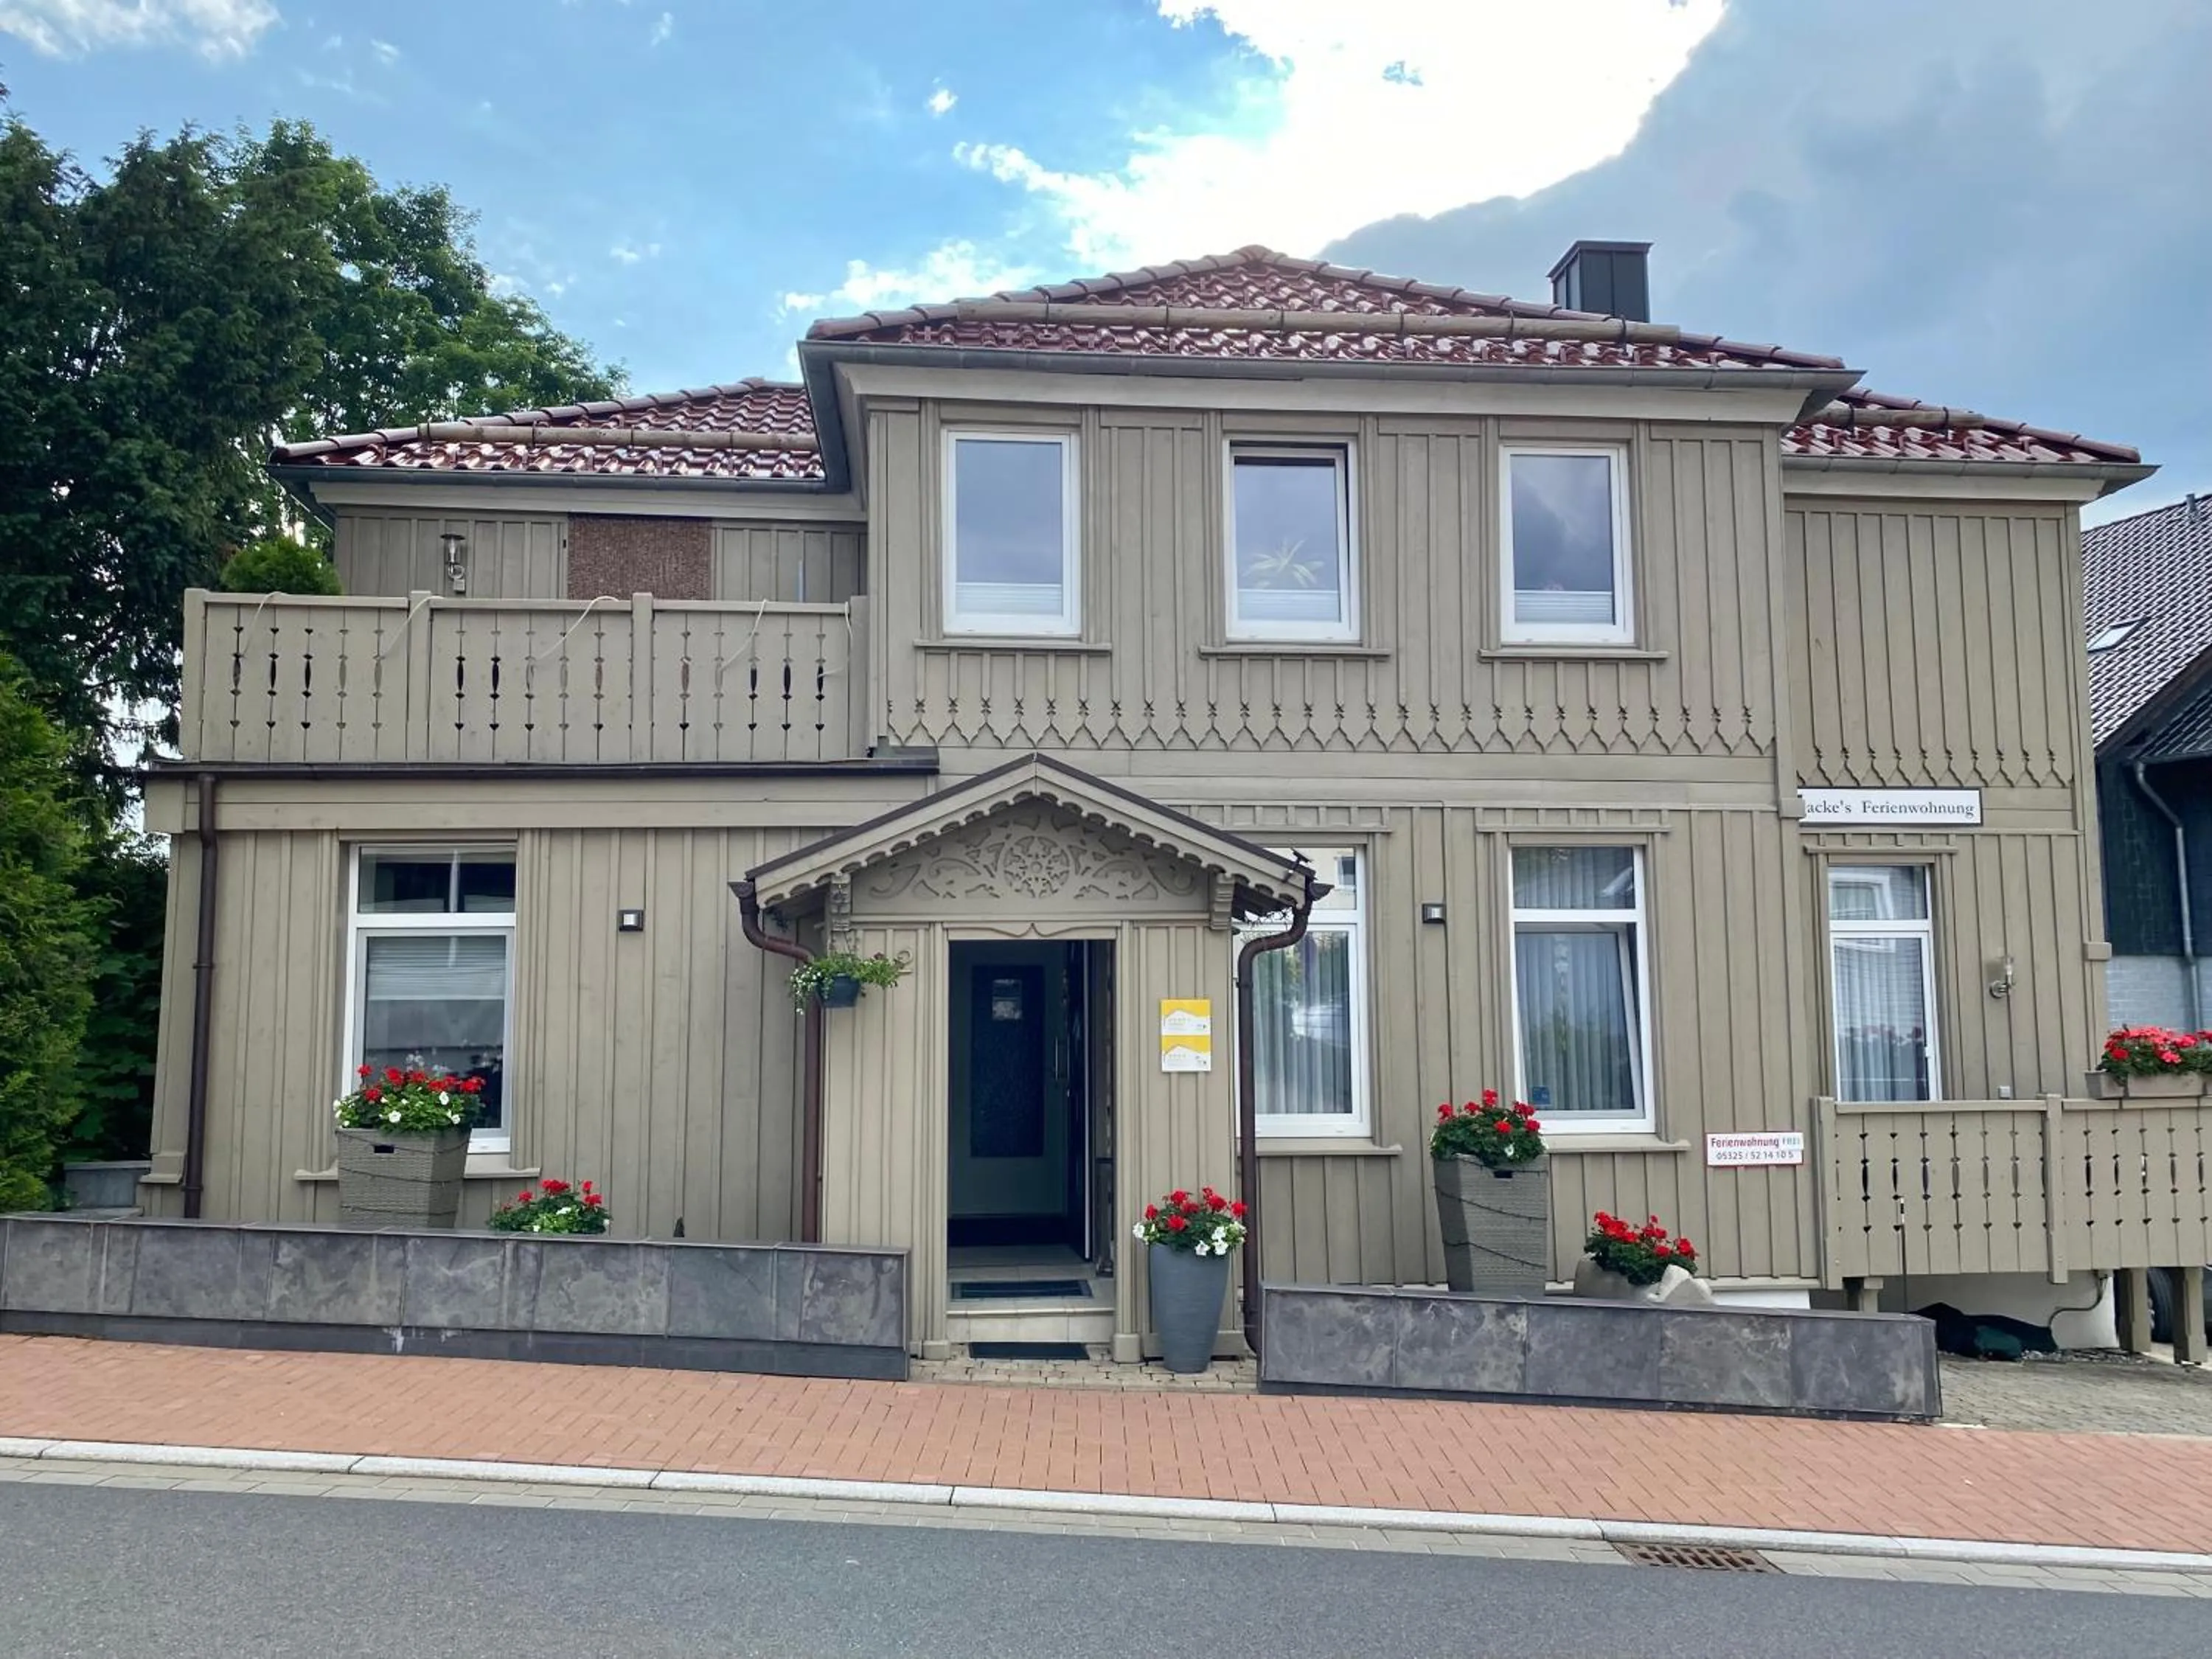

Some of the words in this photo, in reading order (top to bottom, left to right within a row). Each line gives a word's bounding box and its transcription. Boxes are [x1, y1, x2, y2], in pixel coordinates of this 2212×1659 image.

[1806, 800, 1852, 813] acke's
[1862, 800, 1975, 819] Ferienwohnung
[1711, 1137, 1779, 1149] Ferienwohnung
